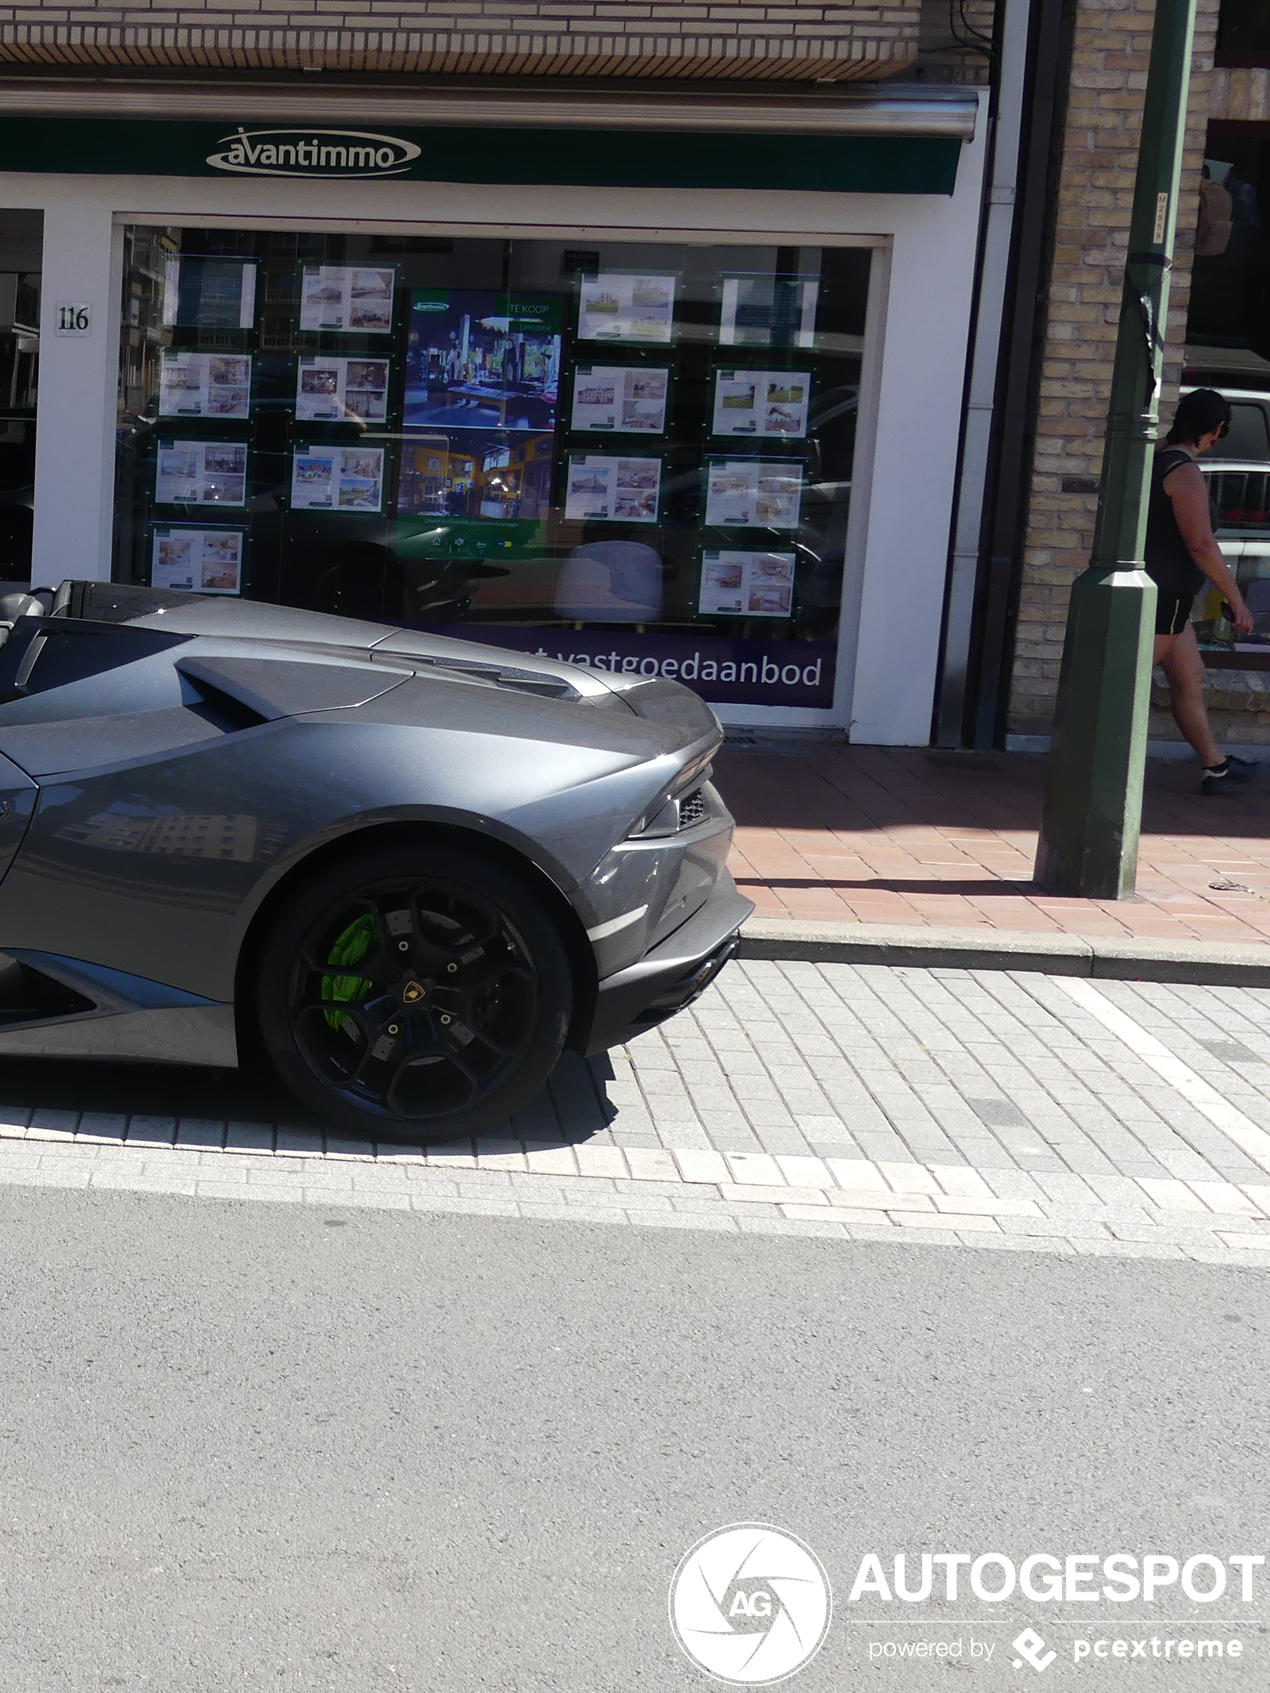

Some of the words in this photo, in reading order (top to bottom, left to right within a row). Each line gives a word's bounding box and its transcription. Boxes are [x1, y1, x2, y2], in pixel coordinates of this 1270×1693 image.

[228, 129, 396, 169] avantimmo
[58, 306, 89, 330] 116
[509, 304, 521, 313] TE
[522, 305, 549, 314] KOOP
